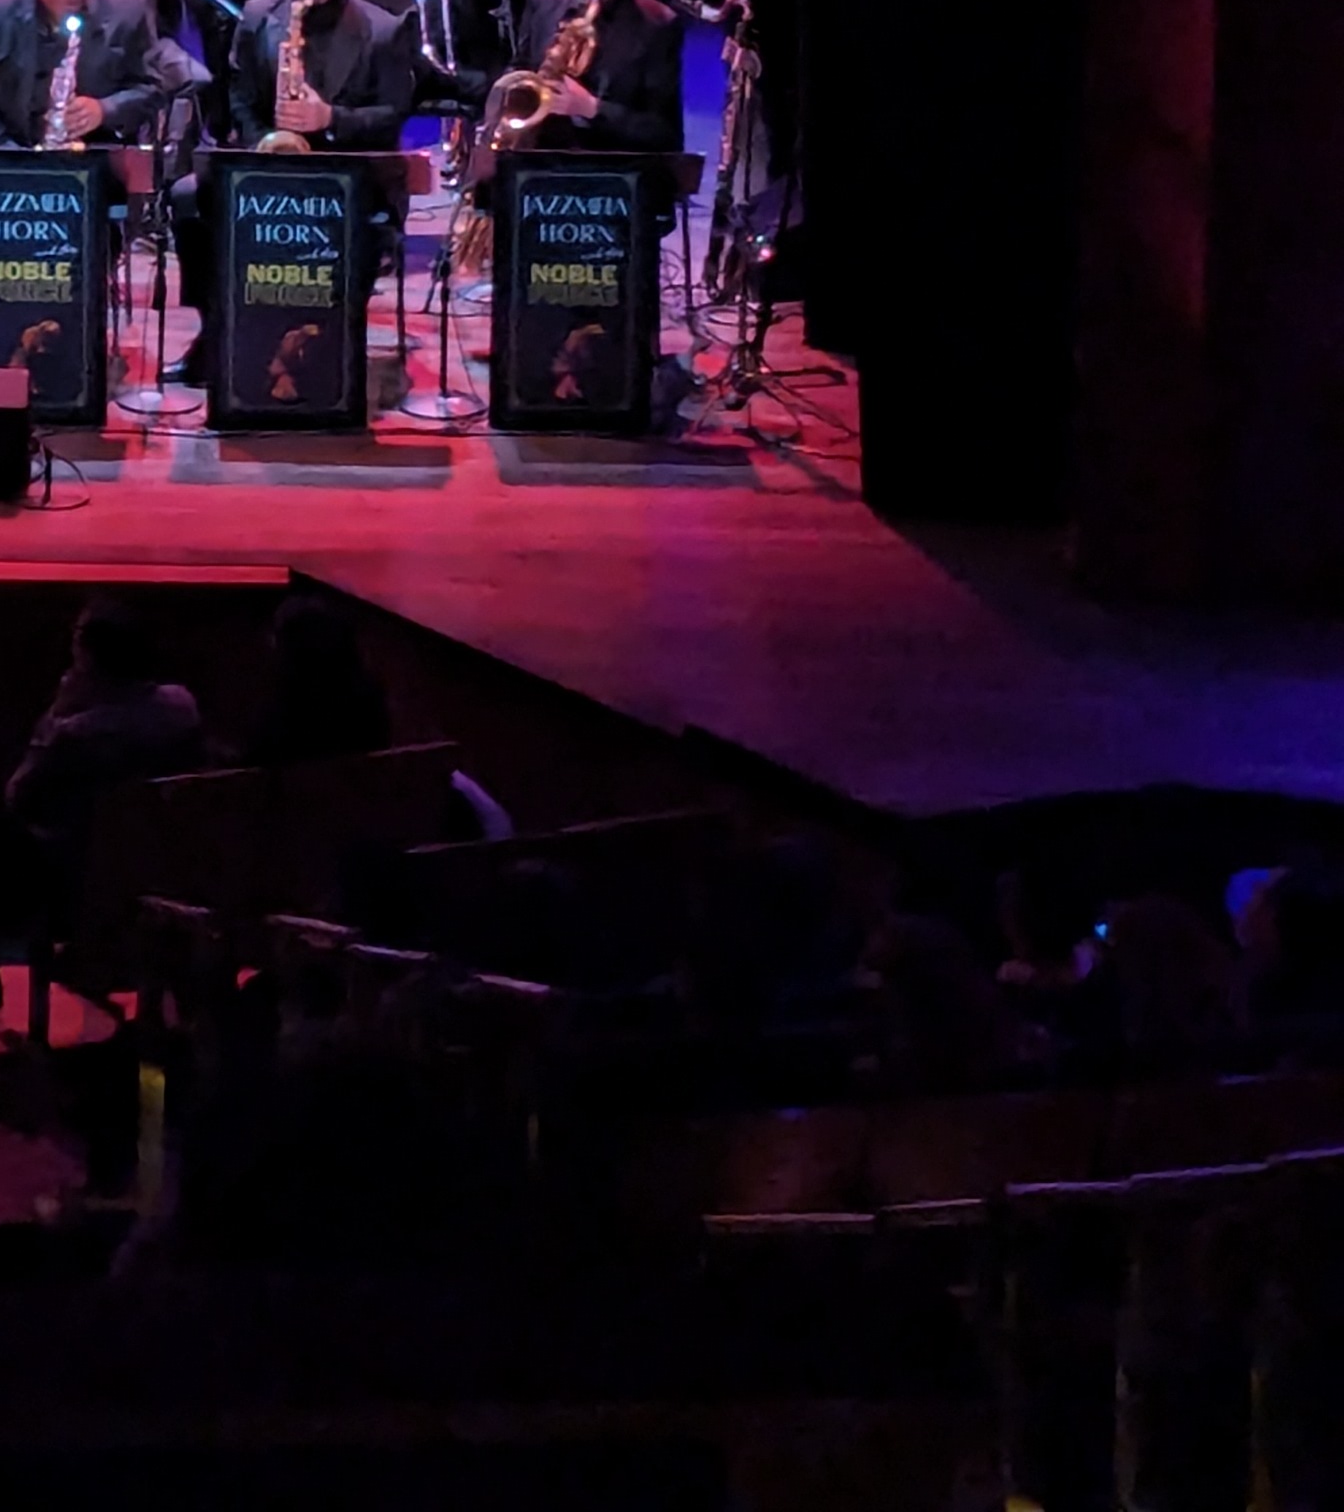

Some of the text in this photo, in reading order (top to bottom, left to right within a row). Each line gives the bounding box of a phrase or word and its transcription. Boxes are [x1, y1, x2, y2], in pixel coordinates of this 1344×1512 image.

[254, 223, 330, 244] HORN
[540, 222, 614, 243] HORN
[247, 263, 333, 285] NOBLE
[530, 262, 618, 285] NOBLE
